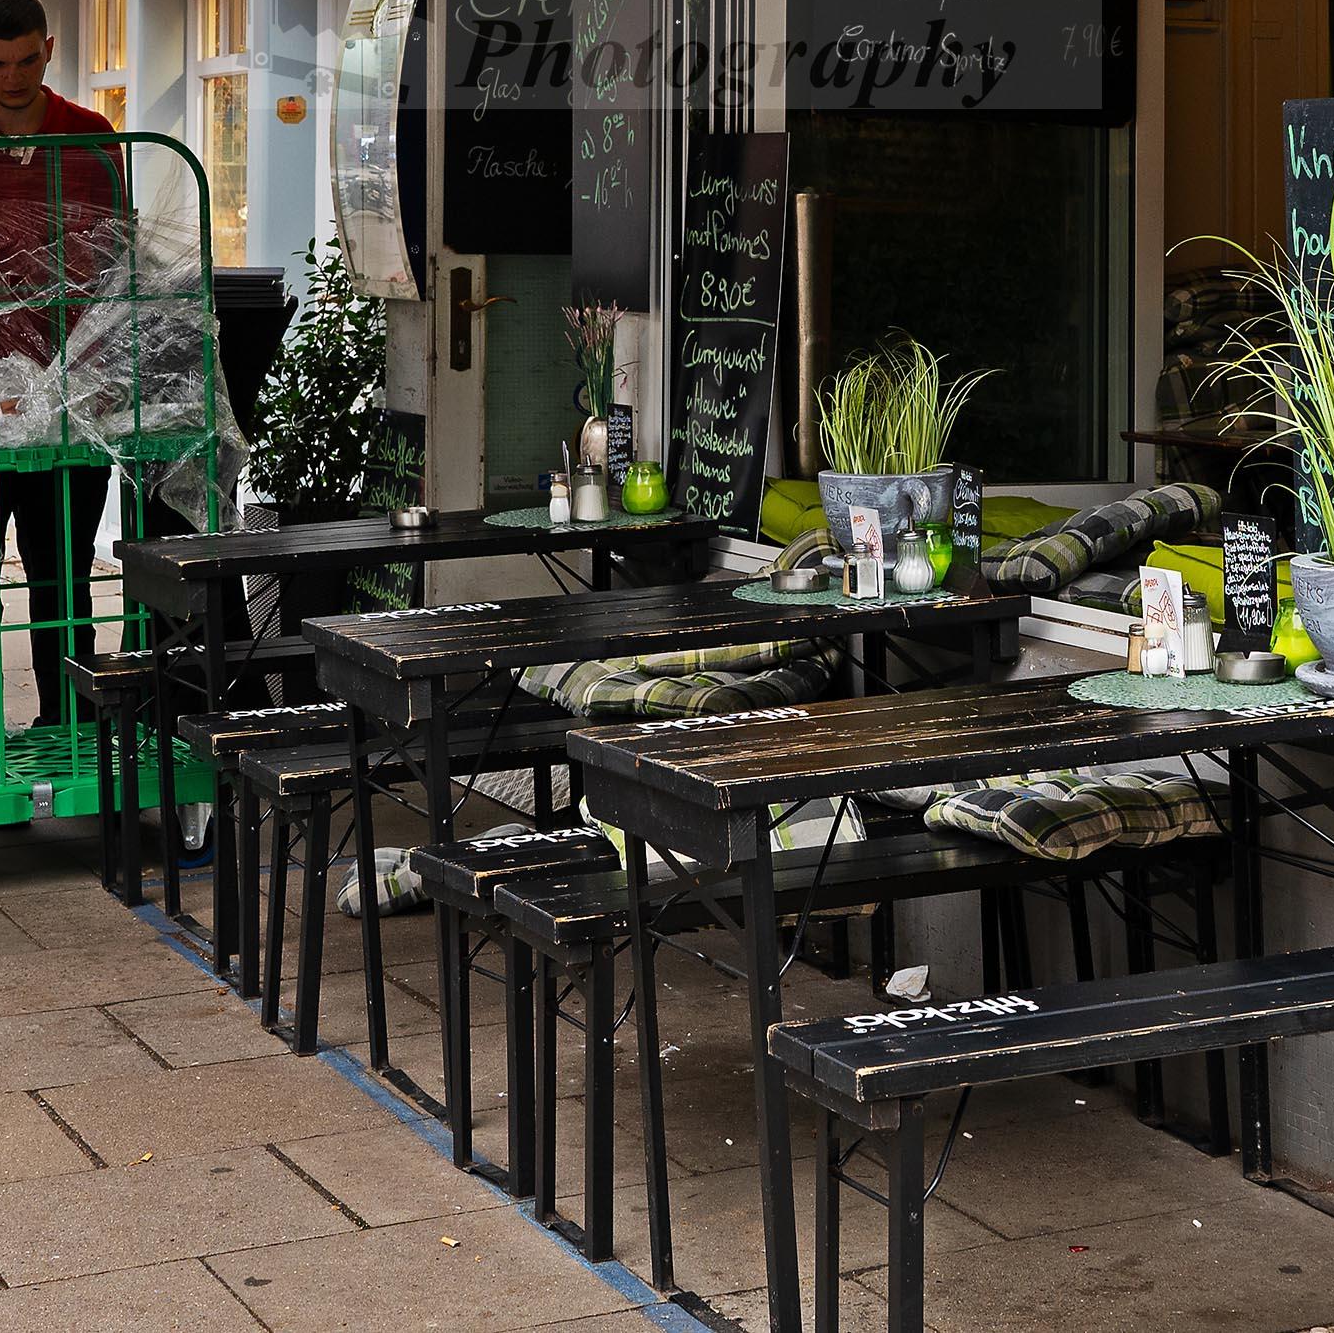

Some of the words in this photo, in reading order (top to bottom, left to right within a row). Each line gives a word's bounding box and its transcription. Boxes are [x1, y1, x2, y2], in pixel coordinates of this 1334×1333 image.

[359, 602, 502, 621] fritz-kola
[228, 701, 349, 721] ritz-kola
[636, 704, 810, 734] fritz-kola
[843, 995, 1040, 1029] fritz-kola
